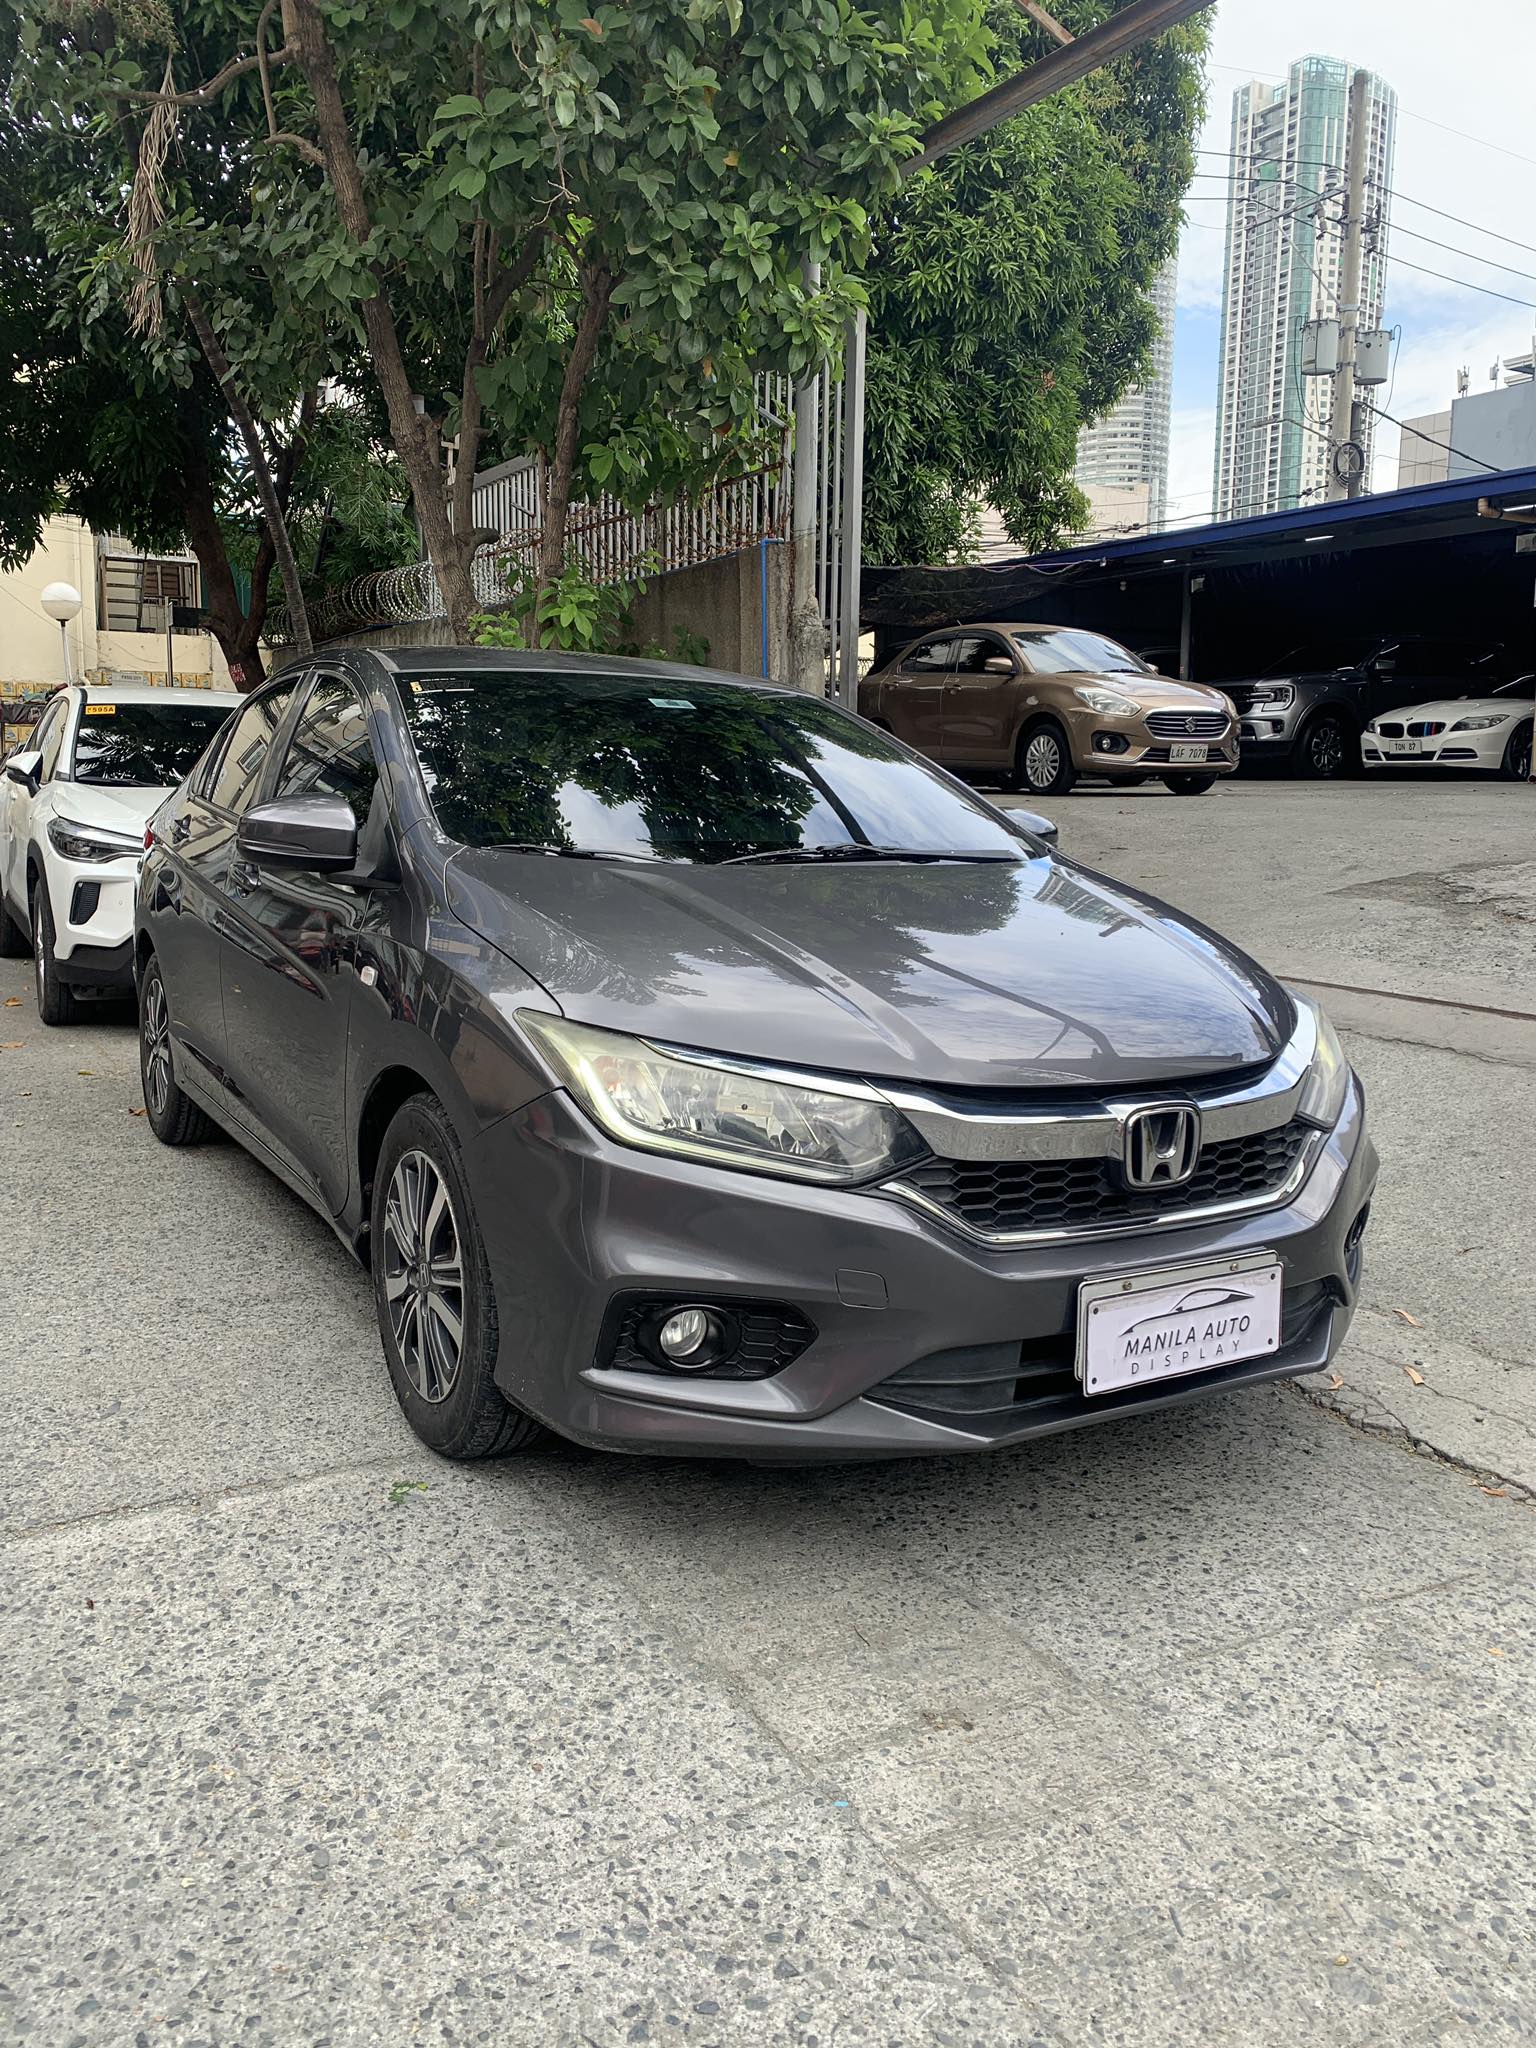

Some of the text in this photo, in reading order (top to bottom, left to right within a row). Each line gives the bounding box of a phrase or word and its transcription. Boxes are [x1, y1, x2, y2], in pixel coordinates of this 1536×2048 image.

[1170, 748, 1206, 759] LAF 7078
[1124, 1315, 1251, 1358] MANILA AUTO
[1131, 1340, 1241, 1375] DISPLAY
